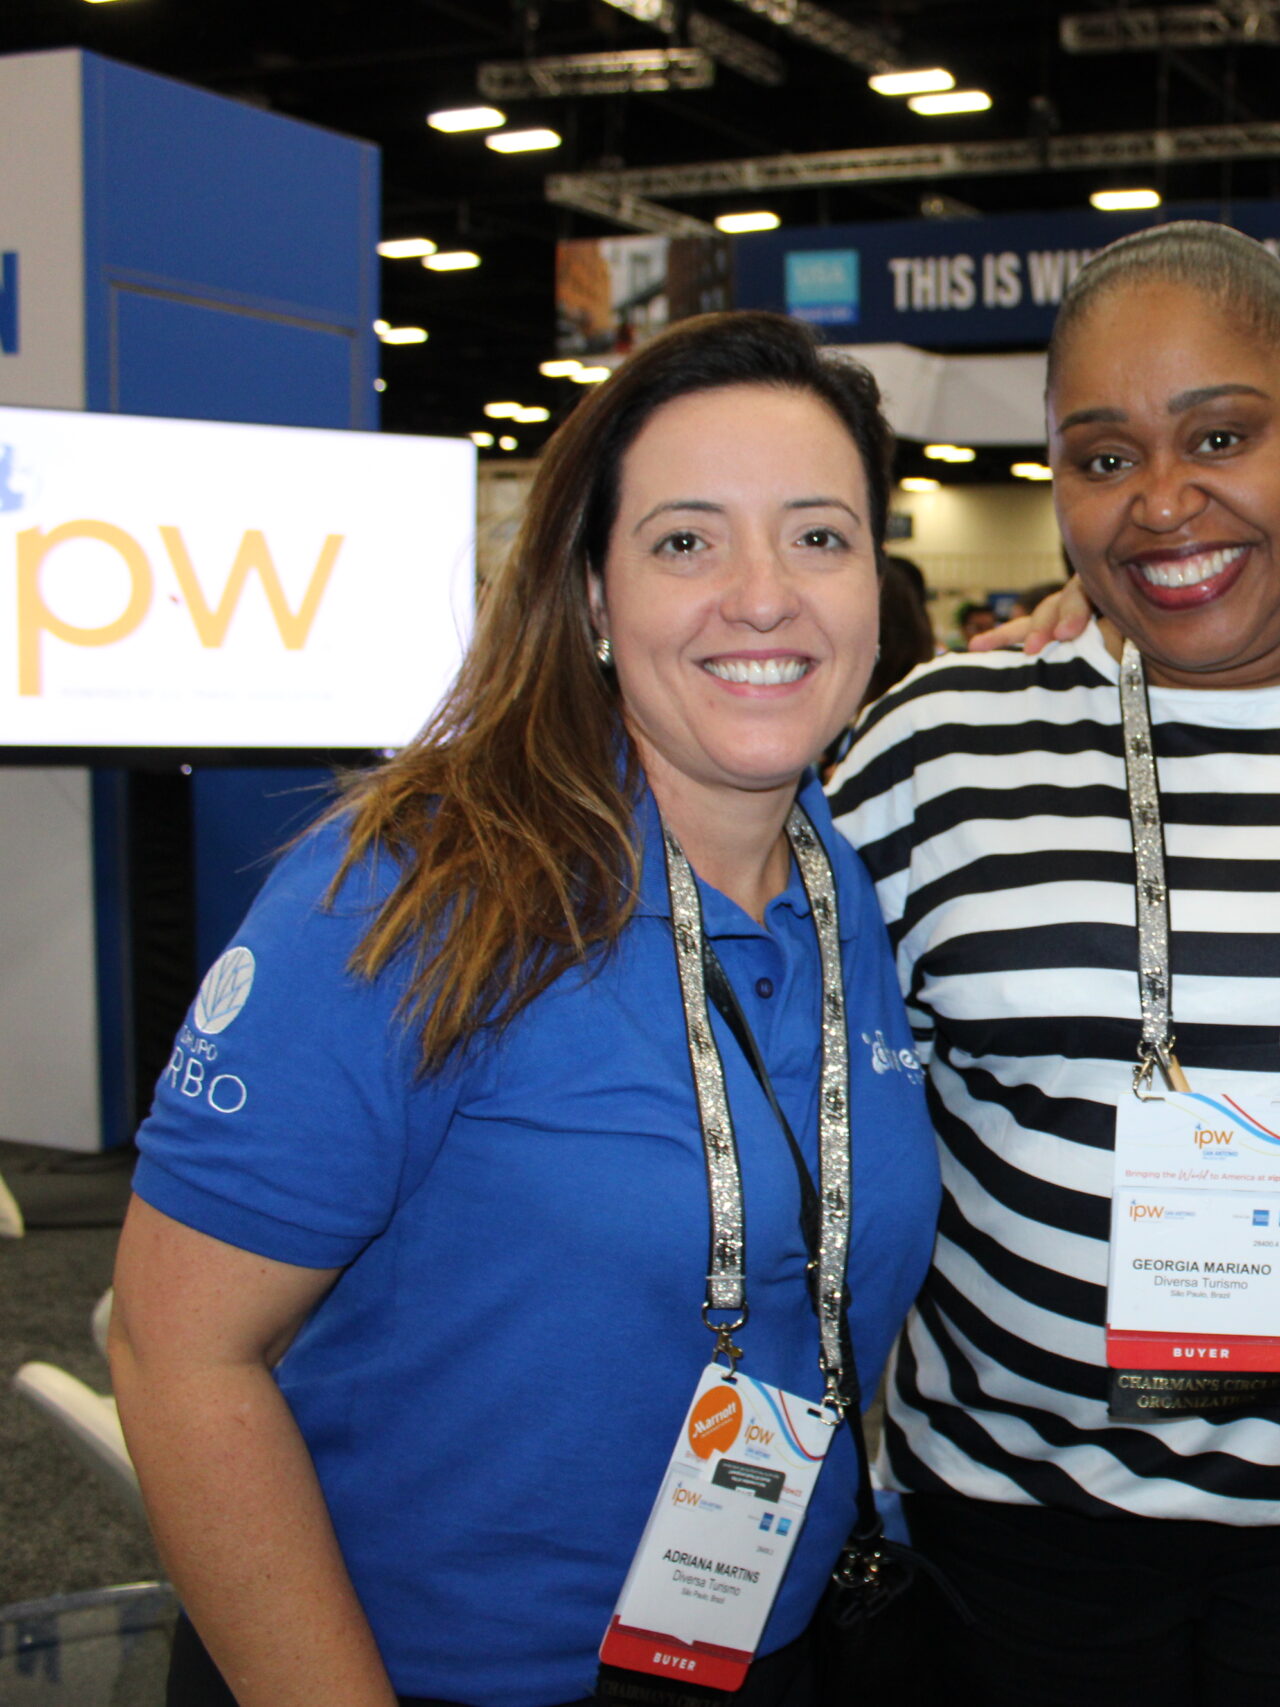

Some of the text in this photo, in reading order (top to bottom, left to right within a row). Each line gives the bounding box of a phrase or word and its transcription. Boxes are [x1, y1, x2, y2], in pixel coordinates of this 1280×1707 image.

[889, 254, 976, 311] THIS
[982, 252, 1021, 308] IS
[16, 519, 345, 697] pw
[1194, 1124, 1234, 1149] ipw
[1125, 1169, 1160, 1179] Bringing
[1221, 1173, 1255, 1181] America
[1257, 1174, 1265, 1182] at
[1129, 1200, 1164, 1222] ipw
[1132, 1258, 1272, 1275] GEORGIA MARIANO
[1154, 1275, 1248, 1290] Diversa Turismo
[1211, 1291, 1231, 1299] Brazil
[1172, 1347, 1230, 1358] BUYER
[1118, 1375, 1219, 1391] CHAIRMAN'S
[693, 1402, 737, 1438] Marriott
[744, 1418, 775, 1445] ipw
[672, 1482, 702, 1506] ipw
[663, 1549, 760, 1584] ADRIANA MARTINS
[672, 1569, 741, 1596] Diversa Turismo
[652, 1652, 697, 1671] BUYER
